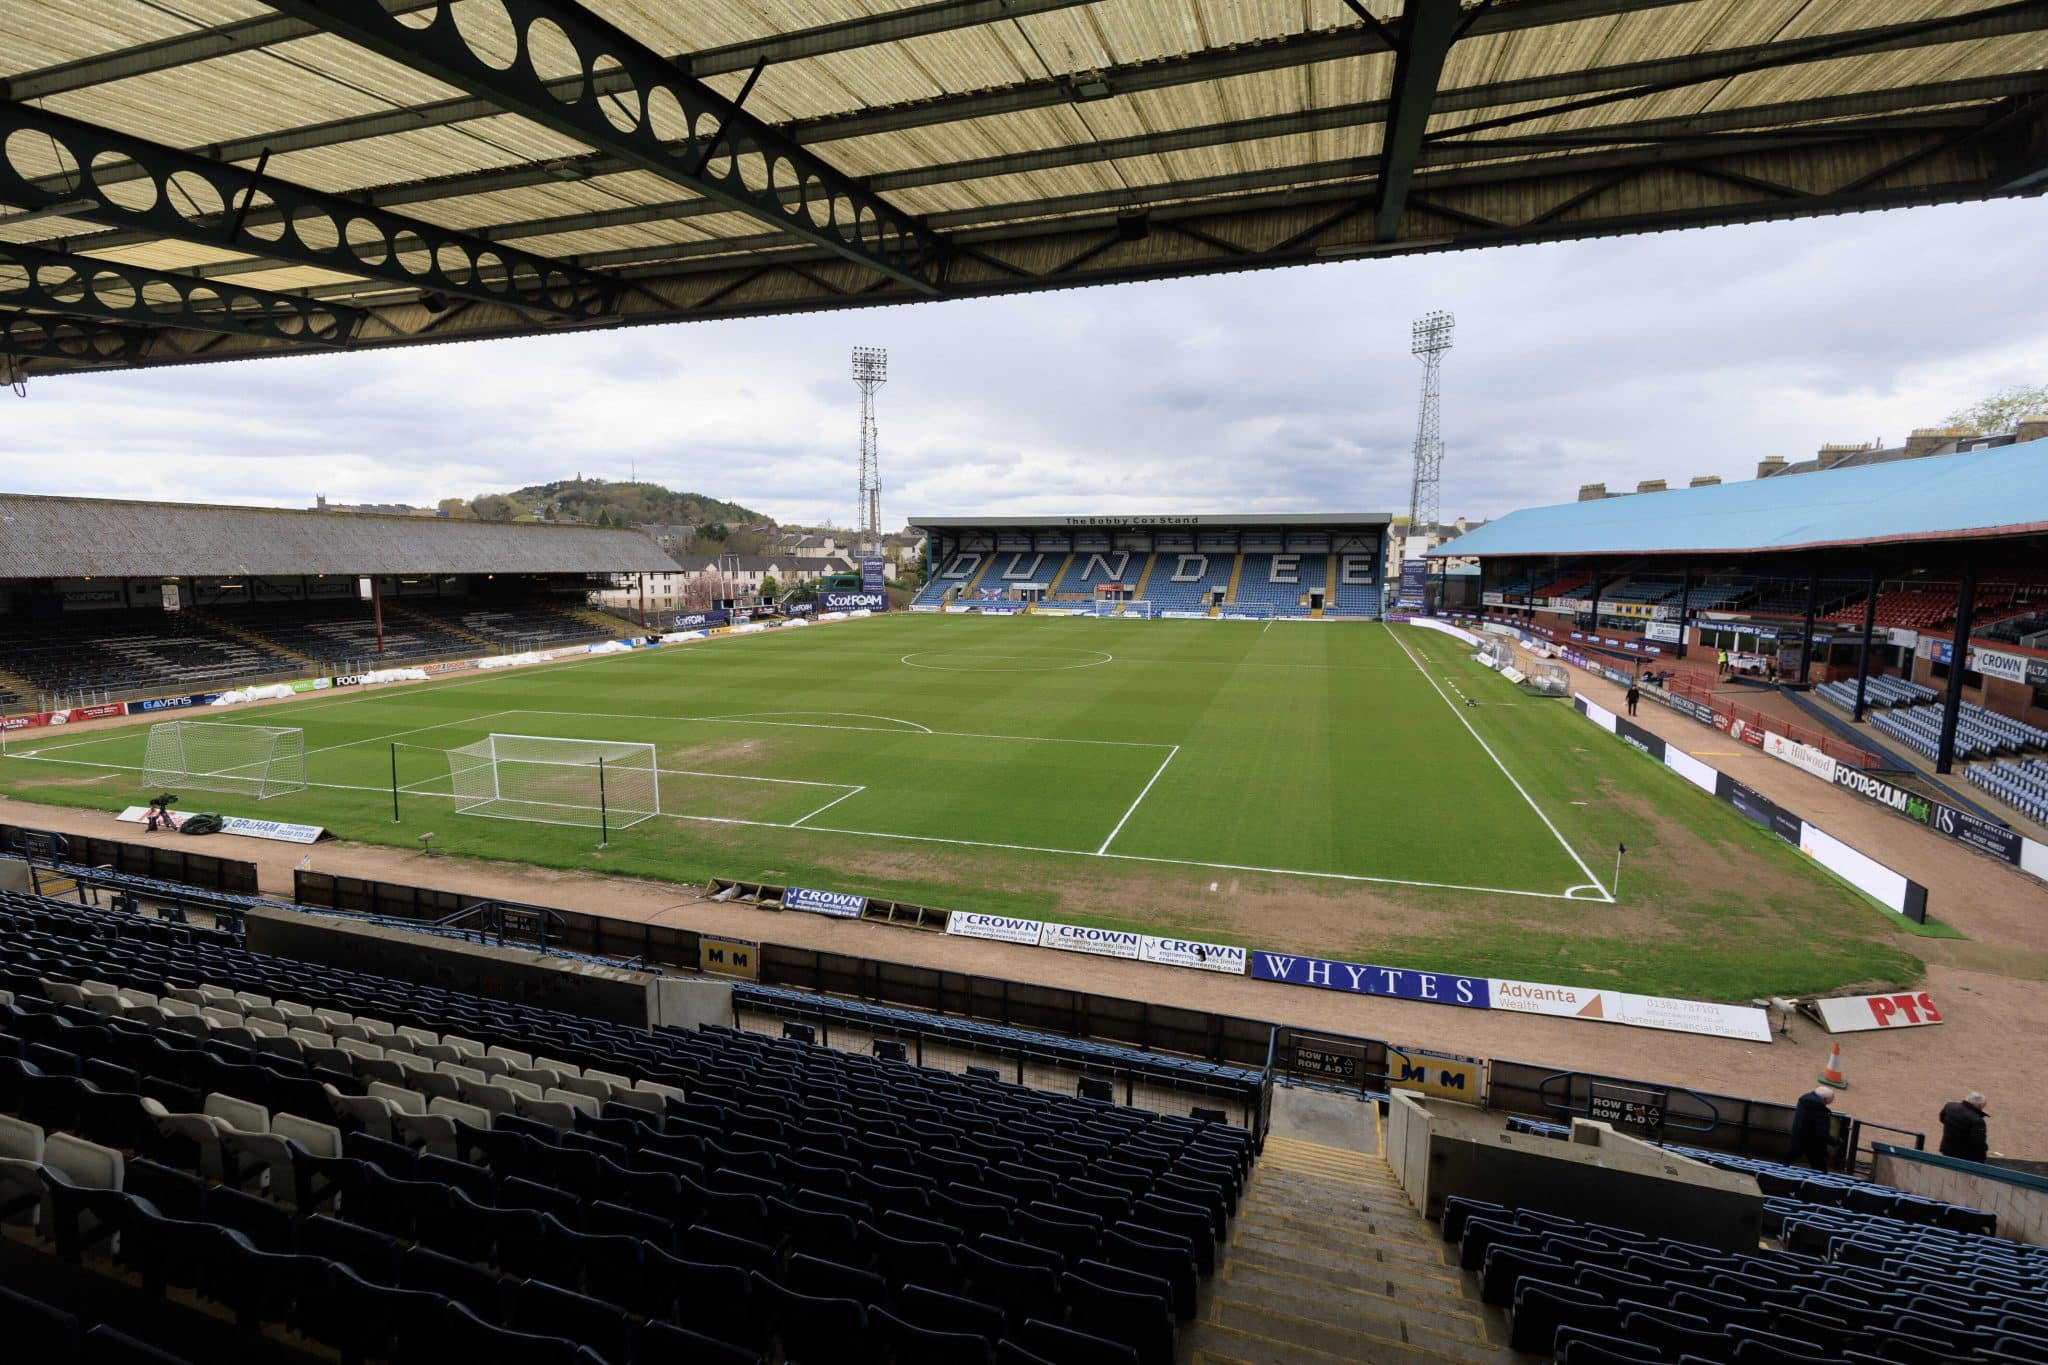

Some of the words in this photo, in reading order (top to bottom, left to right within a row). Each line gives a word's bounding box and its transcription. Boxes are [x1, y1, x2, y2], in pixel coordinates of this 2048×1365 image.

[1090, 517, 1128, 525] Bobby
[1159, 516, 1199, 524] Stand
[941, 550, 1373, 585] DUNDEE
[826, 593, 882, 607] ScotFOAM
[1983, 654, 2022, 673] CROWN
[336, 673, 365, 686] FOOT
[1791, 744, 1831, 772] Hillwood
[1835, 766, 1907, 811] FOOTASYLUM
[231, 819, 280, 832] GRAHAM
[798, 889, 863, 906] CROWN
[966, 914, 1039, 932] CROWN
[1060, 926, 1137, 945] CROWN
[1160, 939, 1243, 960] CROWN
[1265, 954, 1474, 1003] WHYTES
[1500, 982, 1577, 1004] Advanta
[1499, 998, 1540, 1010] Wealth
[1866, 992, 1943, 1027] PTS
[1667, 1019, 1712, 1033] Financial
[1297, 1049, 1322, 1061] ROW
[1297, 1059, 1321, 1070] ROW
[1324, 1064, 1343, 1073] A-D
[1593, 1097, 1622, 1109] ROW
[1592, 1107, 1621, 1120] ROW
[1624, 1113, 1646, 1124] A-D
